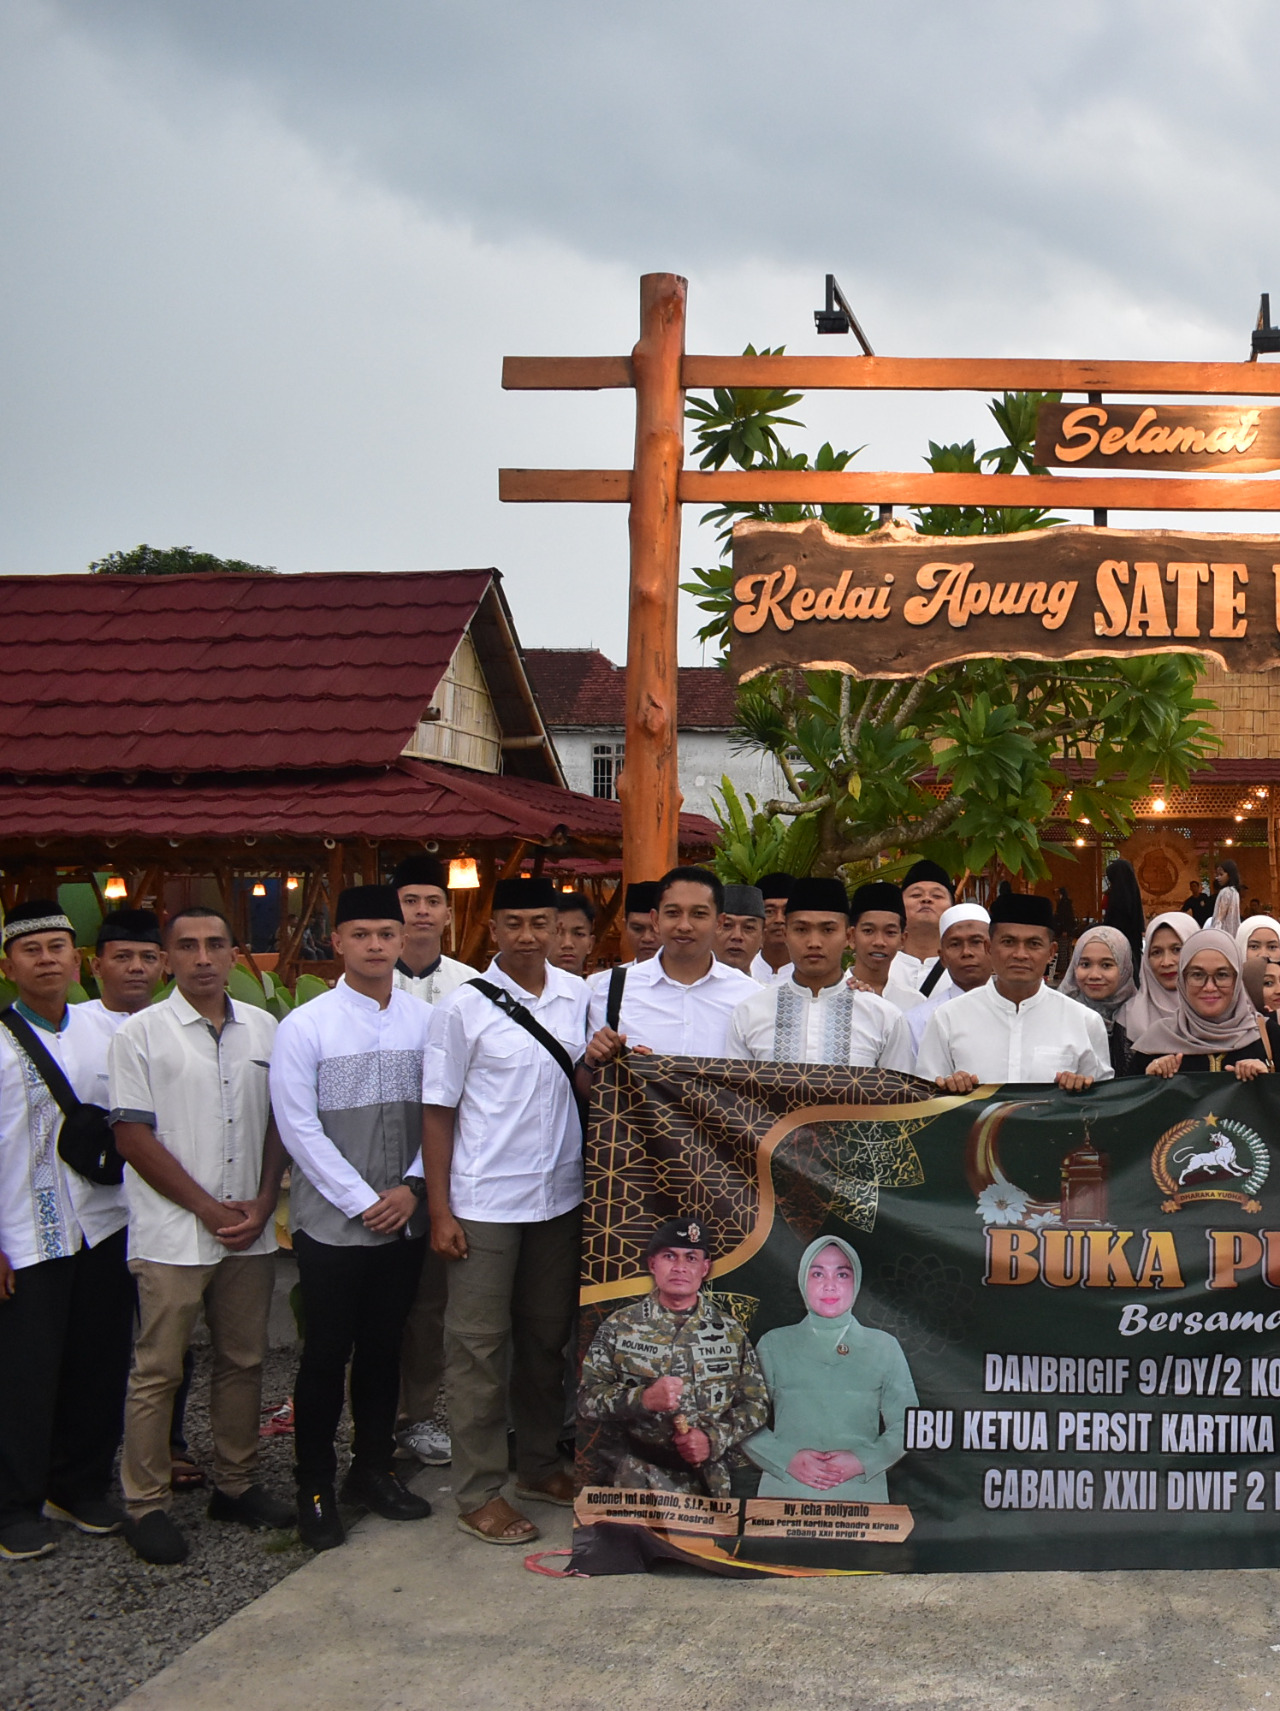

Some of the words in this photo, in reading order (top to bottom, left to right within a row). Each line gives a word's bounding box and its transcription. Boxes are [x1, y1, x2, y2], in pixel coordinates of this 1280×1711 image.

[1055, 407, 1261, 463] Selamat
[733, 564, 895, 633] Kedai
[904, 562, 1078, 630] Apung
[1094, 559, 1249, 638] SATE
[1180, 1191, 1215, 1201] DHARAKA
[1217, 1191, 1242, 1201] YUDHA
[982, 1225, 1185, 1289] BUKA
[622, 1339, 659, 1355] ROLIYANTO
[698, 1347, 716, 1356] TNI
[719, 1345, 732, 1355] AD
[985, 1353, 1130, 1394] DANBRIGIF
[1139, 1354, 1242, 1396] 9/DY/2
[906, 1410, 953, 1450] IBU
[963, 1411, 1048, 1450] KETUA
[1058, 1412, 1152, 1452] PERSIT
[1161, 1413, 1274, 1453] KARTIKA
[984, 1468, 1093, 1509] CABANG
[1102, 1470, 1157, 1510] XXII
[1167, 1471, 1237, 1510] DIVIF
[1246, 1471, 1265, 1510] 2
[587, 1492, 622, 1505] Kolonel
[784, 1503, 798, 1516] Ny.
[801, 1503, 822, 1516] Icha
[825, 1504, 869, 1518] Roliyanto
[678, 1513, 714, 1525] Kostrad
[751, 1518, 774, 1526] Ketua
[803, 1520, 833, 1529] Kartika
[835, 1520, 870, 1530] Chandra
[872, 1522, 899, 1531] Kirana
[786, 1528, 817, 1538] Cabang
